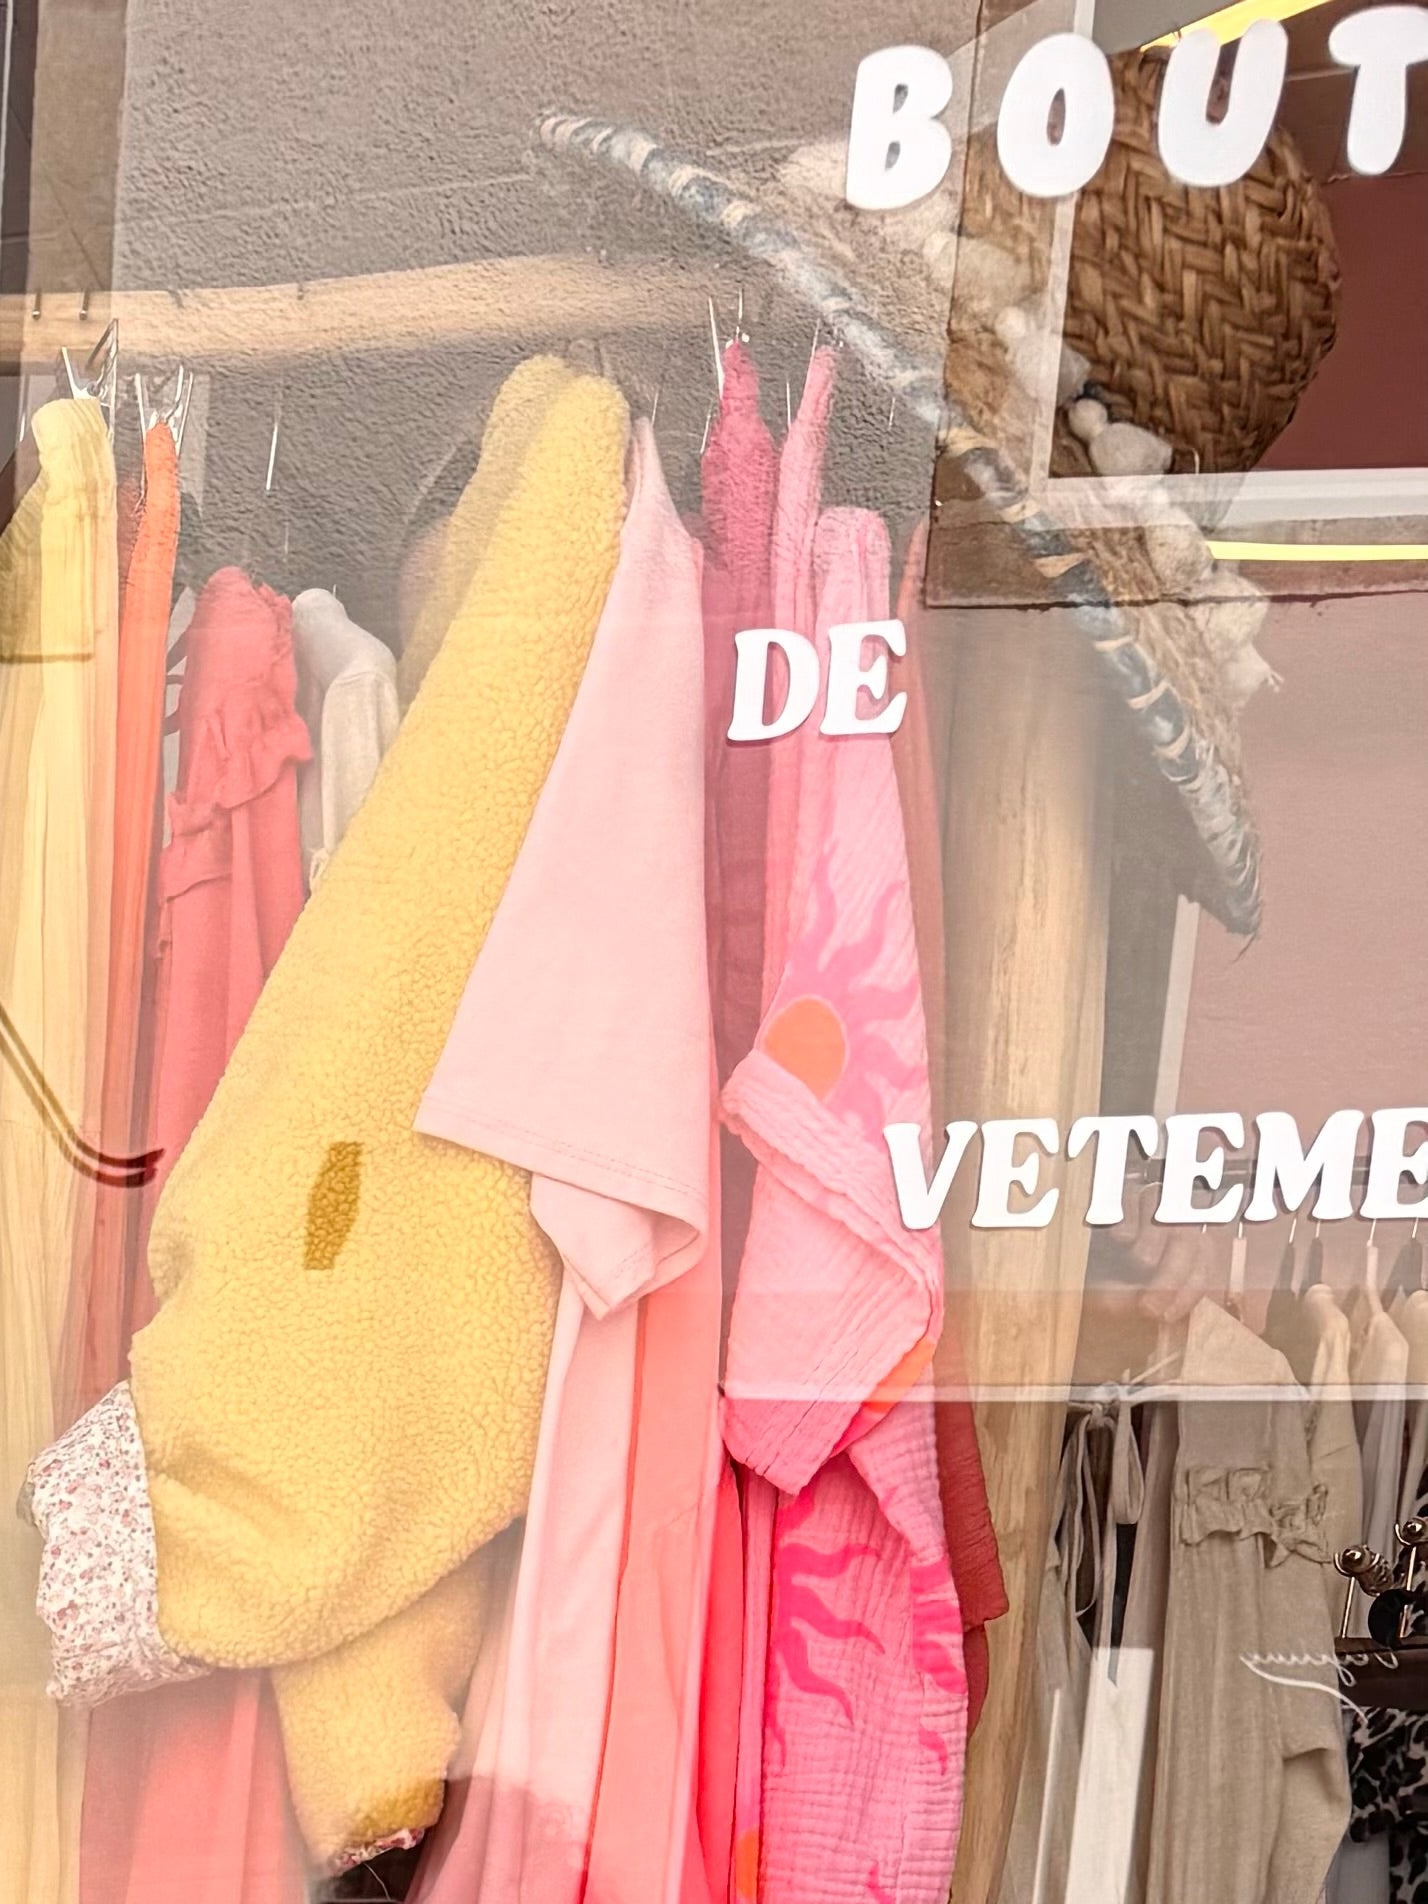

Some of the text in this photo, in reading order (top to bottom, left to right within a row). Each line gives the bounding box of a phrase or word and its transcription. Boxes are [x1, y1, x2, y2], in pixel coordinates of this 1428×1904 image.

[845, 5, 1428, 209] BOUT
[727, 619, 907, 742] DE
[885, 1107, 1428, 1230] VETEME
